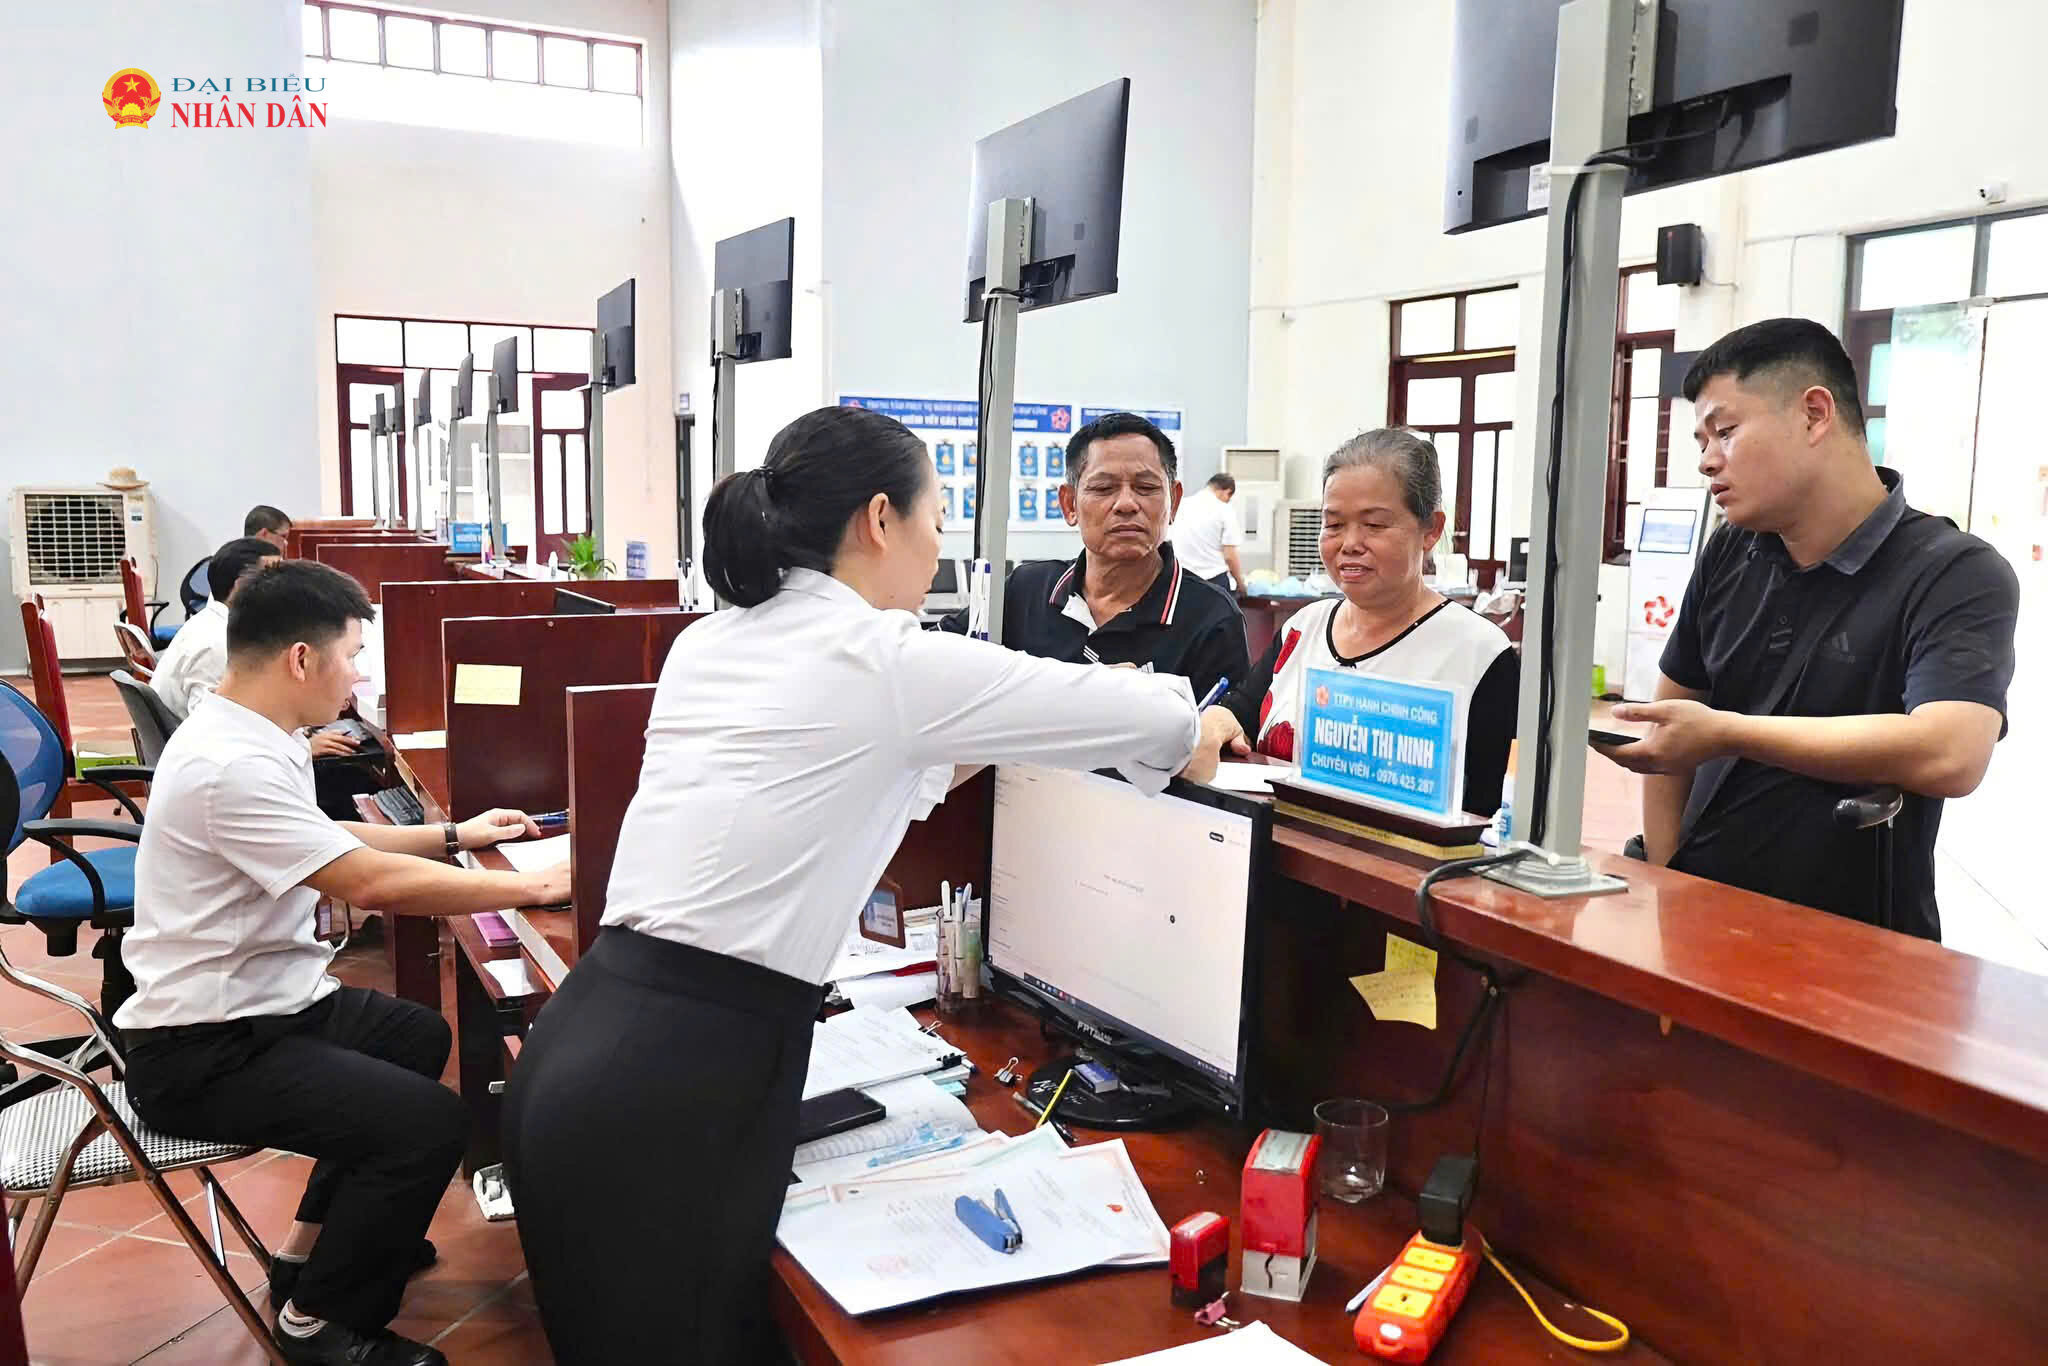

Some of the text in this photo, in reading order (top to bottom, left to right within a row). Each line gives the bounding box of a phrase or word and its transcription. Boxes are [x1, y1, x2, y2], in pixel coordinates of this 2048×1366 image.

[1411, 705, 1438, 725] CÔNG
[1313, 714, 1435, 769] NGUYỄN THỊ NINH
[1311, 752, 1347, 773] CHUYÊN
[1348, 761, 1371, 779] VIÊN
